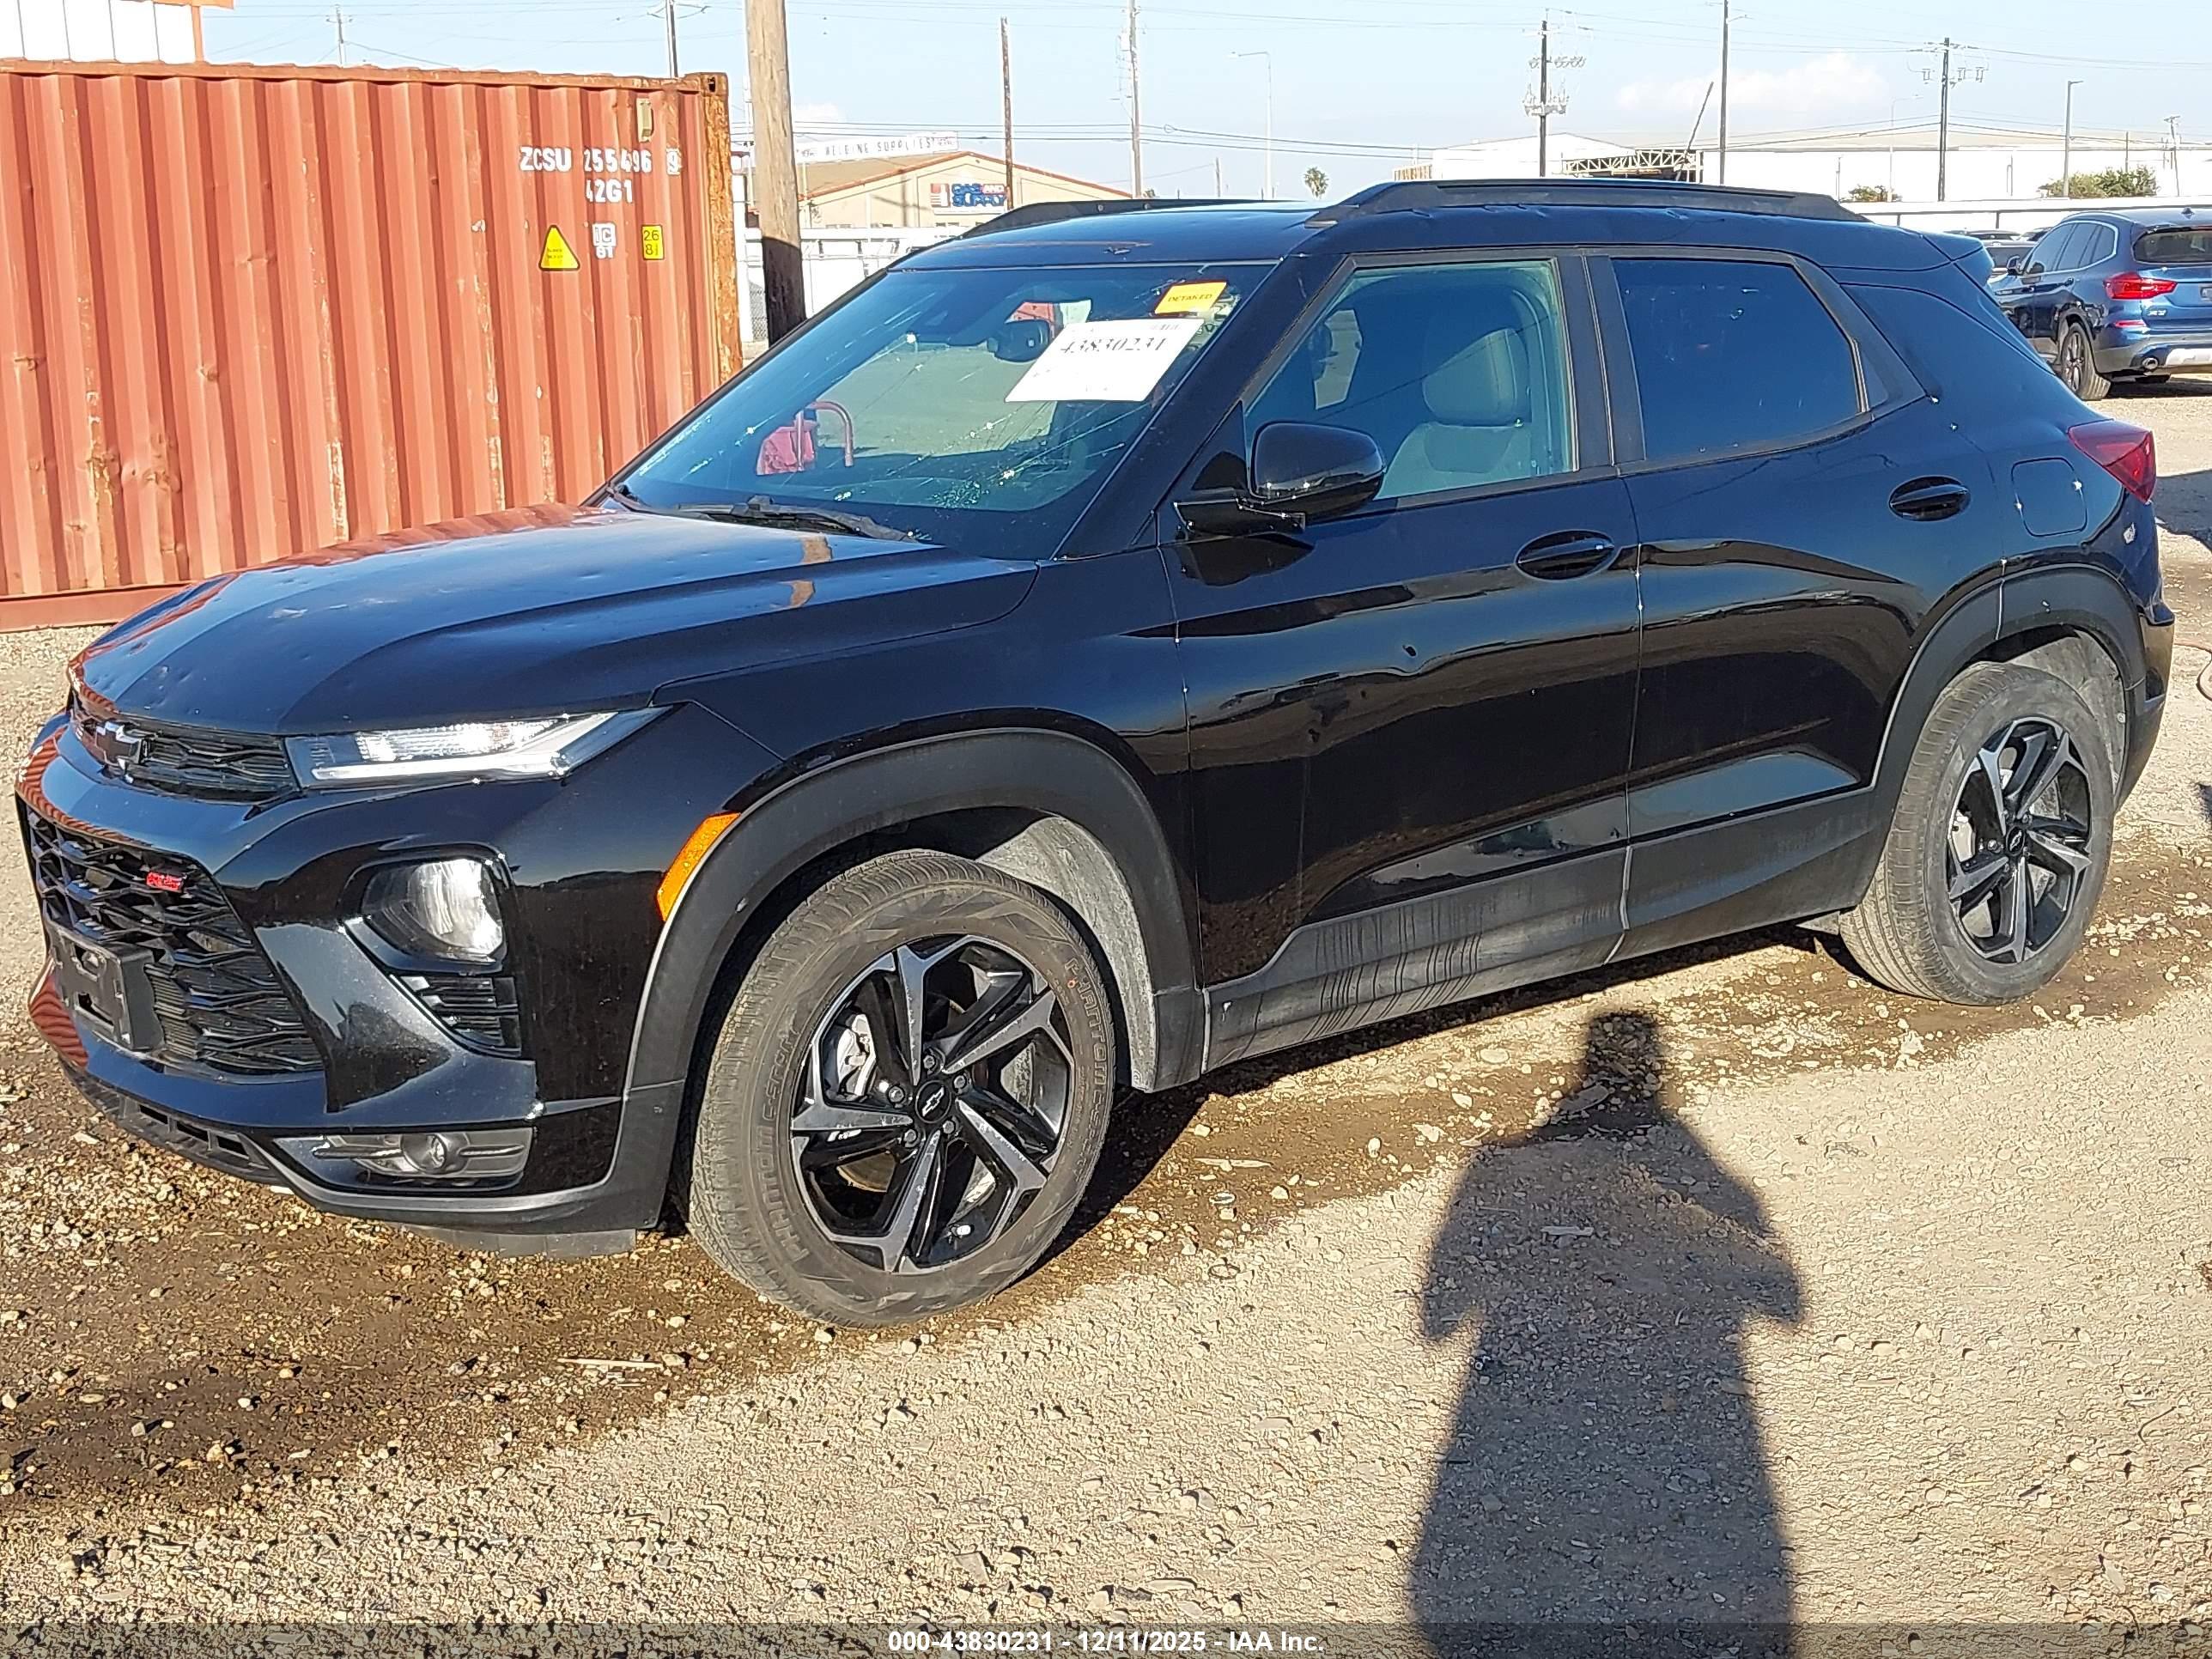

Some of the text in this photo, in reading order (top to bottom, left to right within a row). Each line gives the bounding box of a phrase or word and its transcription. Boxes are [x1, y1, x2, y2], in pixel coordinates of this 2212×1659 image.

[520, 146, 572, 173] ZCSU
[583, 148, 653, 173] 255496
[586, 178, 633, 203] 42G1
